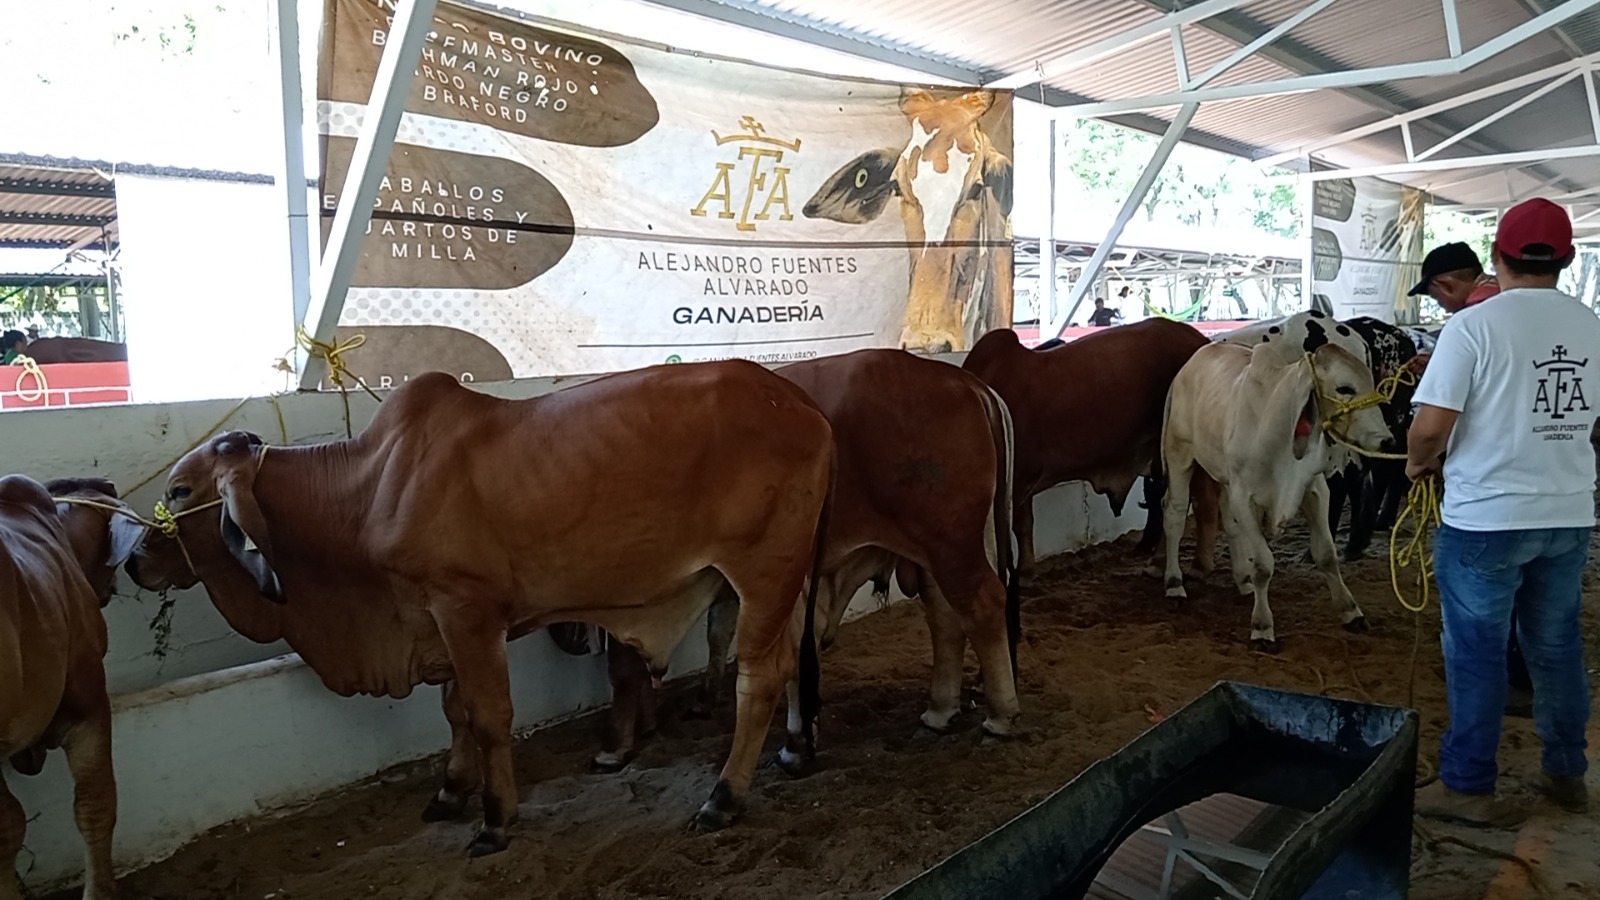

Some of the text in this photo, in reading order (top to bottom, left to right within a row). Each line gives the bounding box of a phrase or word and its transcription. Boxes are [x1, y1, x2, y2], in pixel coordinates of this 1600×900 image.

[488, 31, 603, 66] BOVINO
[414, 64, 567, 112] RDO NEGRO
[517, 71, 578, 94] ROJO
[424, 85, 527, 123] BRAFORD
[379, 176, 504, 203] ABALLOS
[324, 194, 528, 225] EPAÑOLES Y
[365, 220, 517, 244] ARTOS DE
[392, 243, 476, 261] MILLA
[638, 251, 858, 274] ALEJANDRO FUENTES
[704, 277, 808, 296] ALVARADO
[673, 300, 824, 324] GANADERÍA
